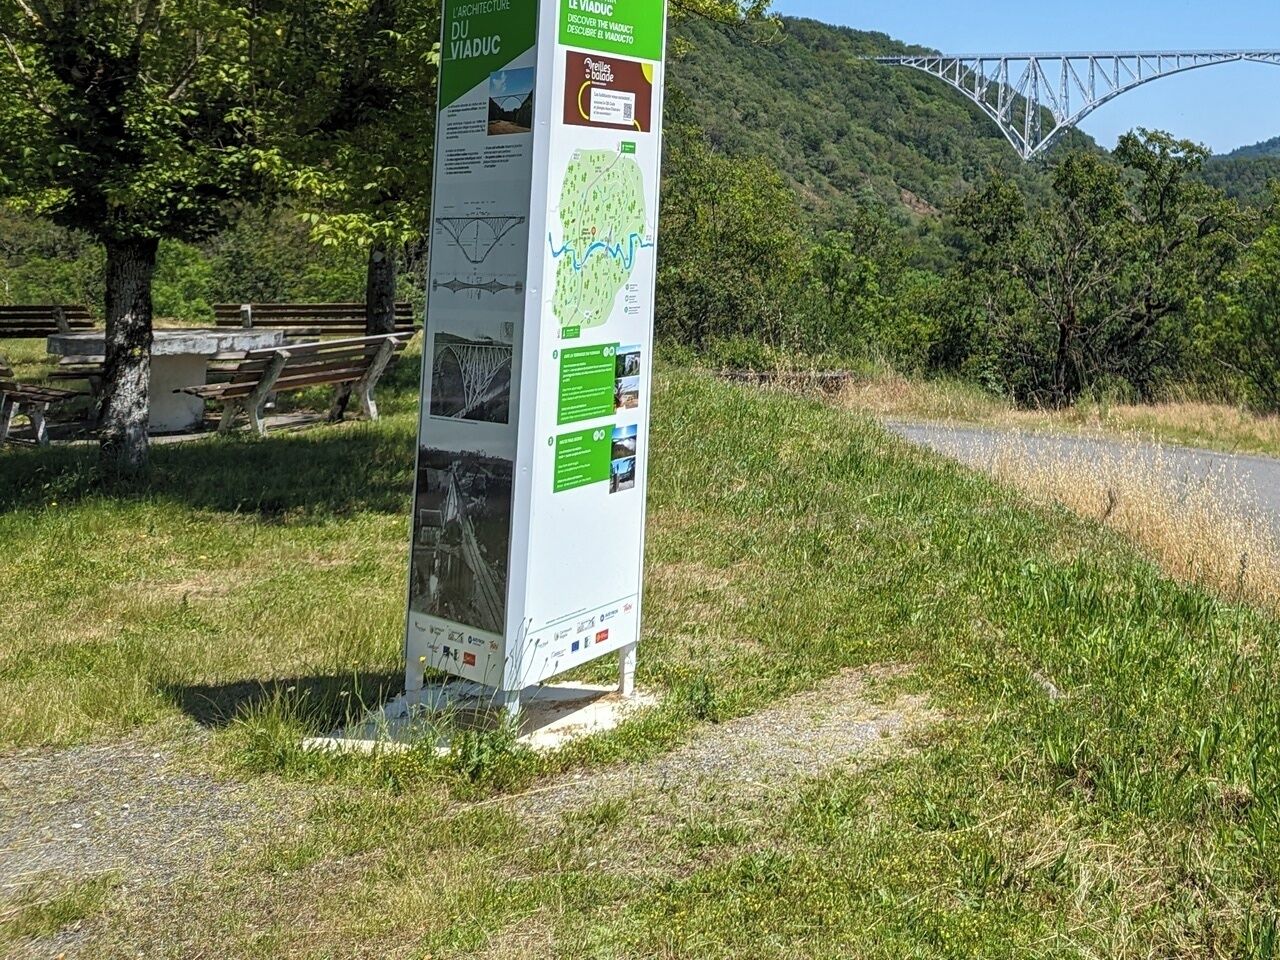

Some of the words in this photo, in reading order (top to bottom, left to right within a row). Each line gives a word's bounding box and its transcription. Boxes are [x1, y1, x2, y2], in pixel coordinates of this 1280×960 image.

[451, 20, 469, 40] DU
[567, 13, 597, 27] DISCOVER
[597, 19, 608, 29] THE
[608, 21, 634, 34] VIADUCT
[567, 24, 597, 38] DESCUBRE
[597, 30, 604, 39] EL
[604, 31, 634, 45] VIADUCTO
[451, 35, 501, 60] VIADUC
[591, 70, 614, 82] balade
